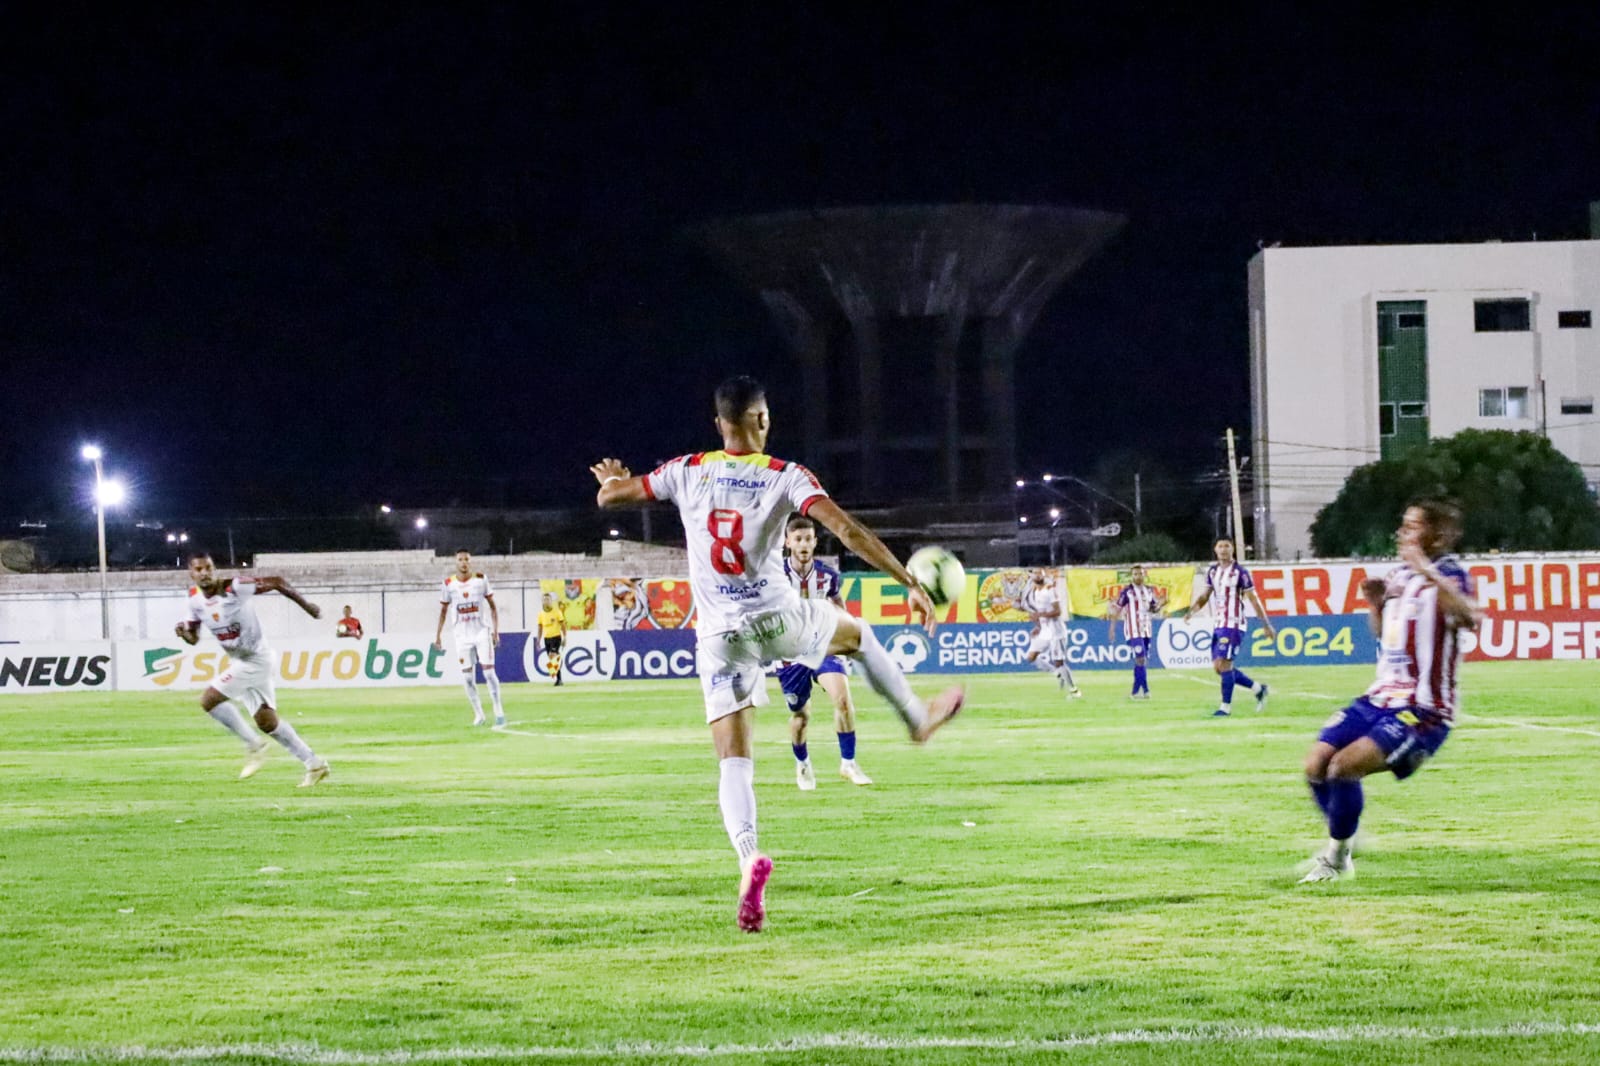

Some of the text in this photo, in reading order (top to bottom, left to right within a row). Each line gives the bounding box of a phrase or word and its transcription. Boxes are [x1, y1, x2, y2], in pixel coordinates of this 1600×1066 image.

[717, 477, 766, 489] PETROLINA
[708, 509, 745, 575] 8
[1100, 584, 1168, 600] JOM
[939, 628, 1088, 649] CAMPEOO
[1169, 623, 1212, 651] be
[1251, 626, 1354, 657] 2024
[191, 638, 446, 682] surobet
[533, 637, 607, 676] bet
[939, 644, 1131, 666] PERNAMCANO
